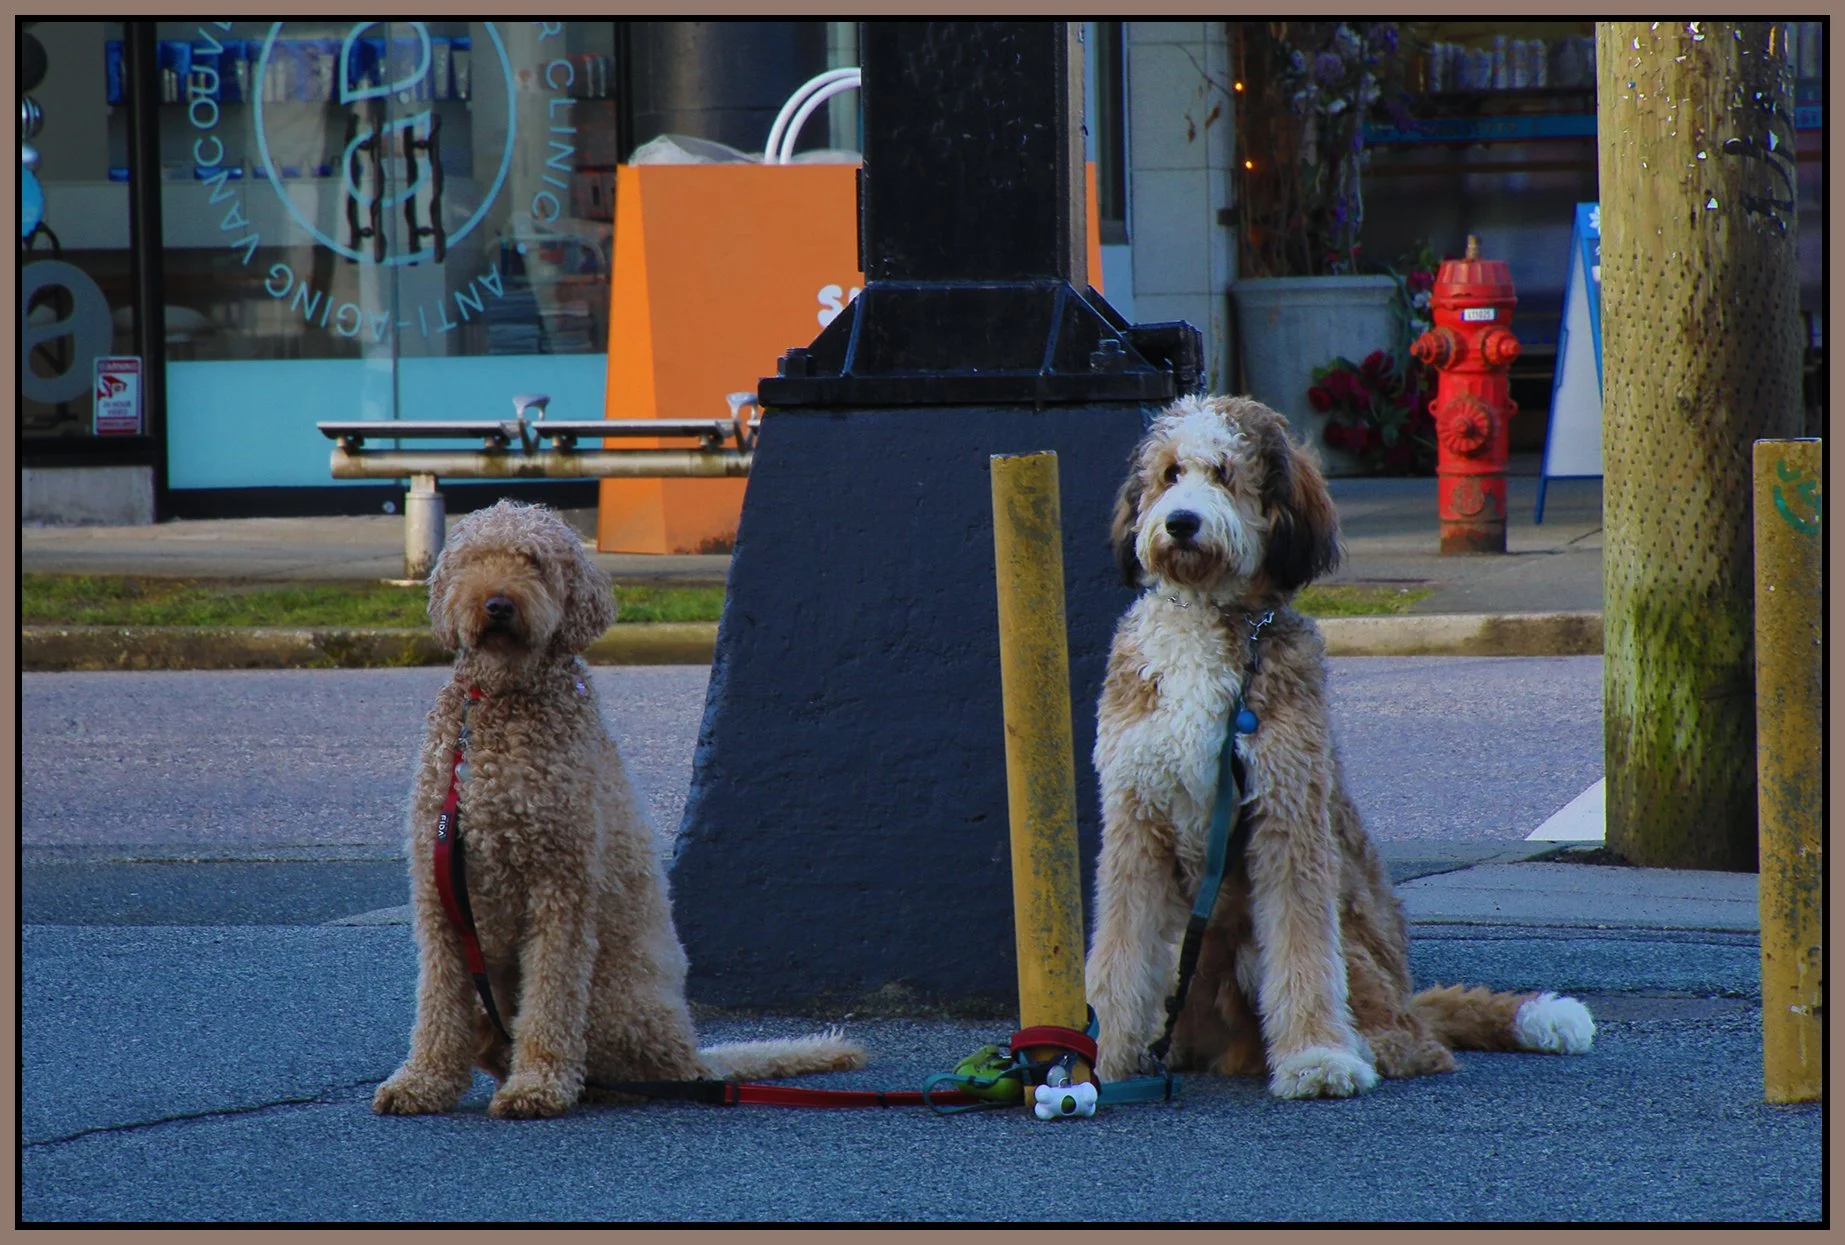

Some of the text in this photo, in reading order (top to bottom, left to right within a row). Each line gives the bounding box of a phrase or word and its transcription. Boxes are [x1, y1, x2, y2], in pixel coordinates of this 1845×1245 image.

[188, 22, 504, 341] ANTI-AGING VANCOUV
[532, 59, 578, 223] CLINIC
